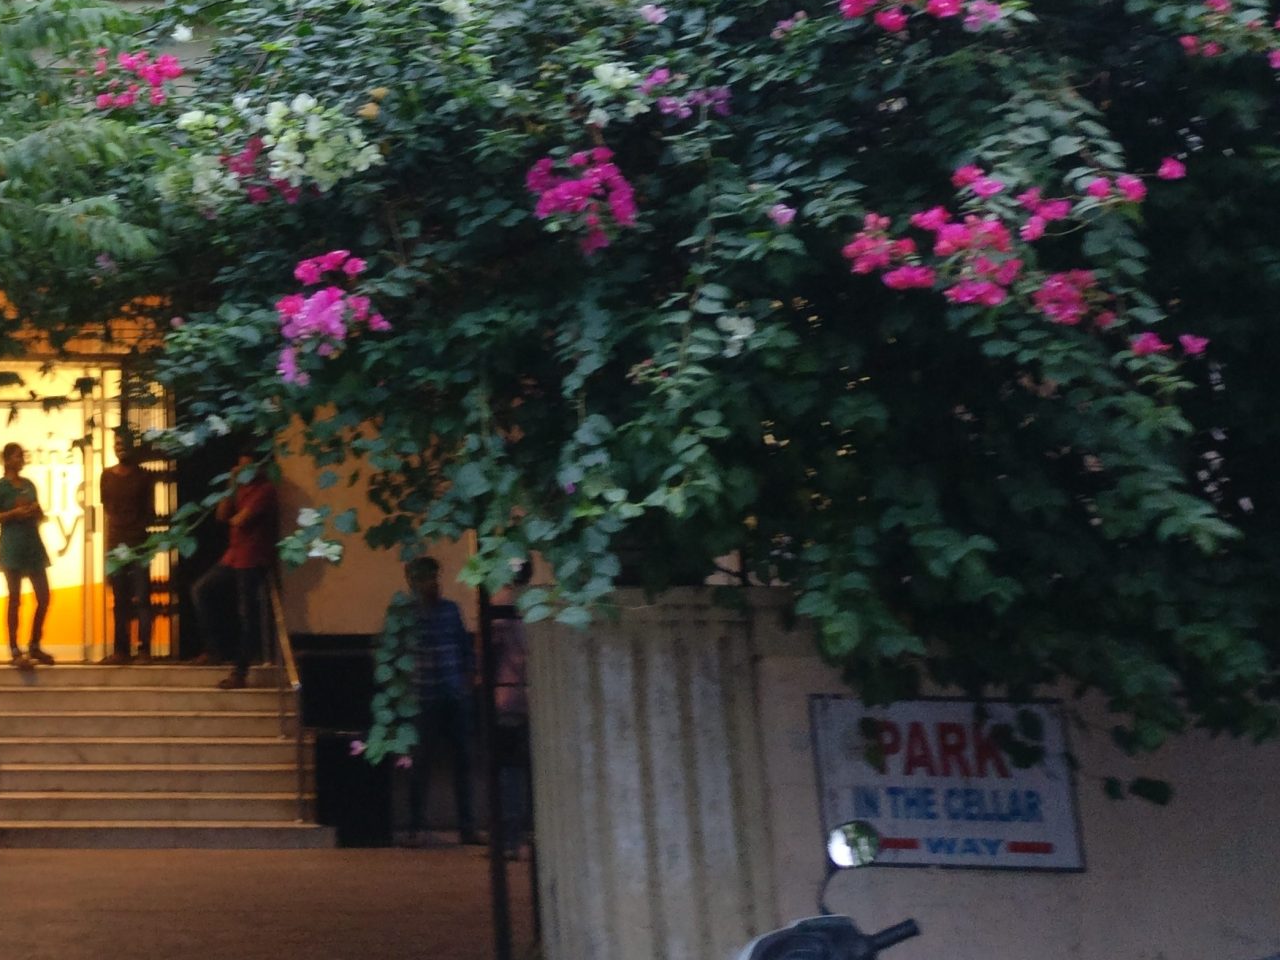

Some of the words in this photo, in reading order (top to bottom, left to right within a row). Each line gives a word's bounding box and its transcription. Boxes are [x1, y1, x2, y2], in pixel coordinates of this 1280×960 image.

[872, 720, 1013, 779] PARK
[886, 786, 940, 820] THE
[945, 787, 1044, 822] CELLAR
[924, 837, 1004, 855] WAY
